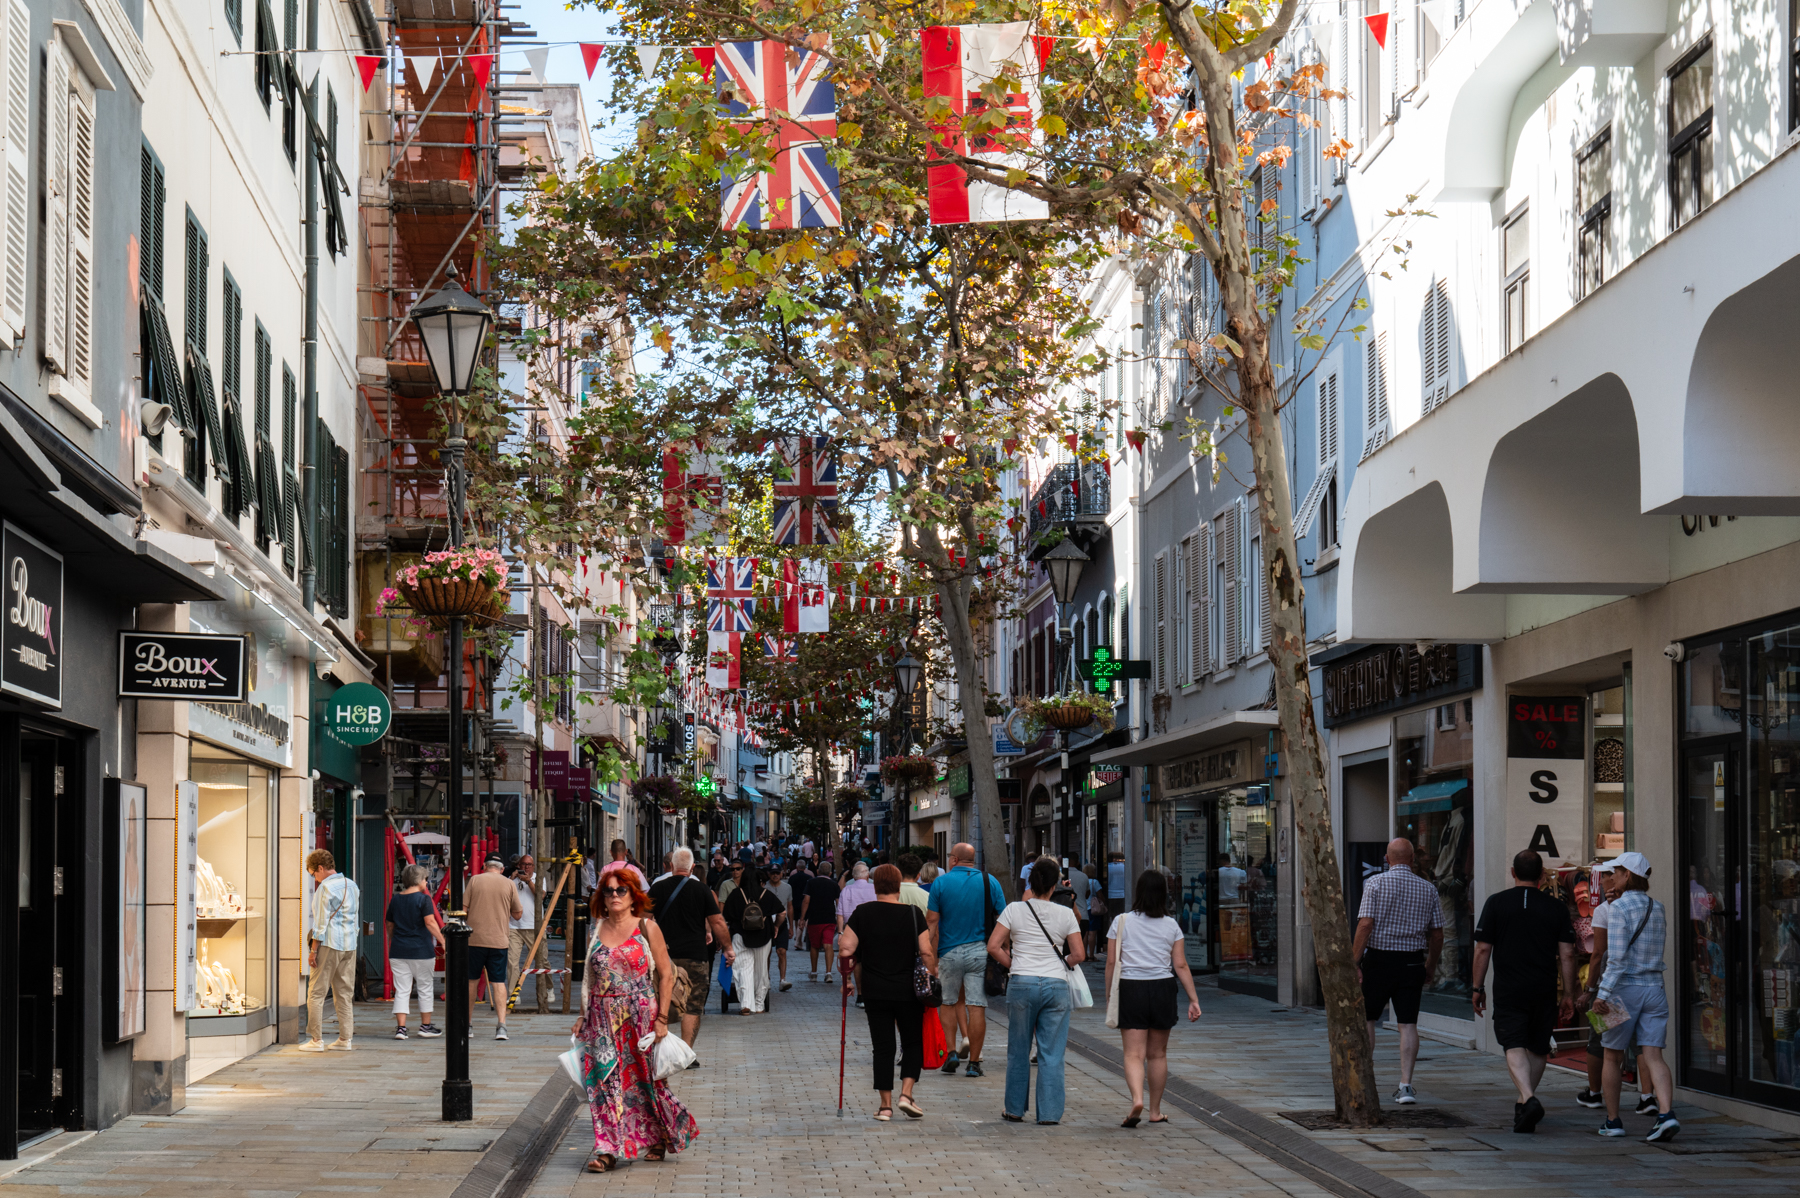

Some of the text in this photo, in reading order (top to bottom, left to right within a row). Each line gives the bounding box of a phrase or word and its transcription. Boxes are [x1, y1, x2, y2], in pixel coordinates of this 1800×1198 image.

[11, 556, 56, 655] Boux
[19, 645, 47, 671] AVENUE
[135, 642, 227, 681] Boux
[152, 677, 207, 689] AVENUE
[1325, 649, 1391, 717] SUPERDRY
[336, 704, 382, 724] H&B
[1515, 703, 1579, 722] SALE
[1535, 731, 1557, 749] %
[1097, 772, 1122, 783] HEUER
[1591, 896, 1599, 905] OFF
